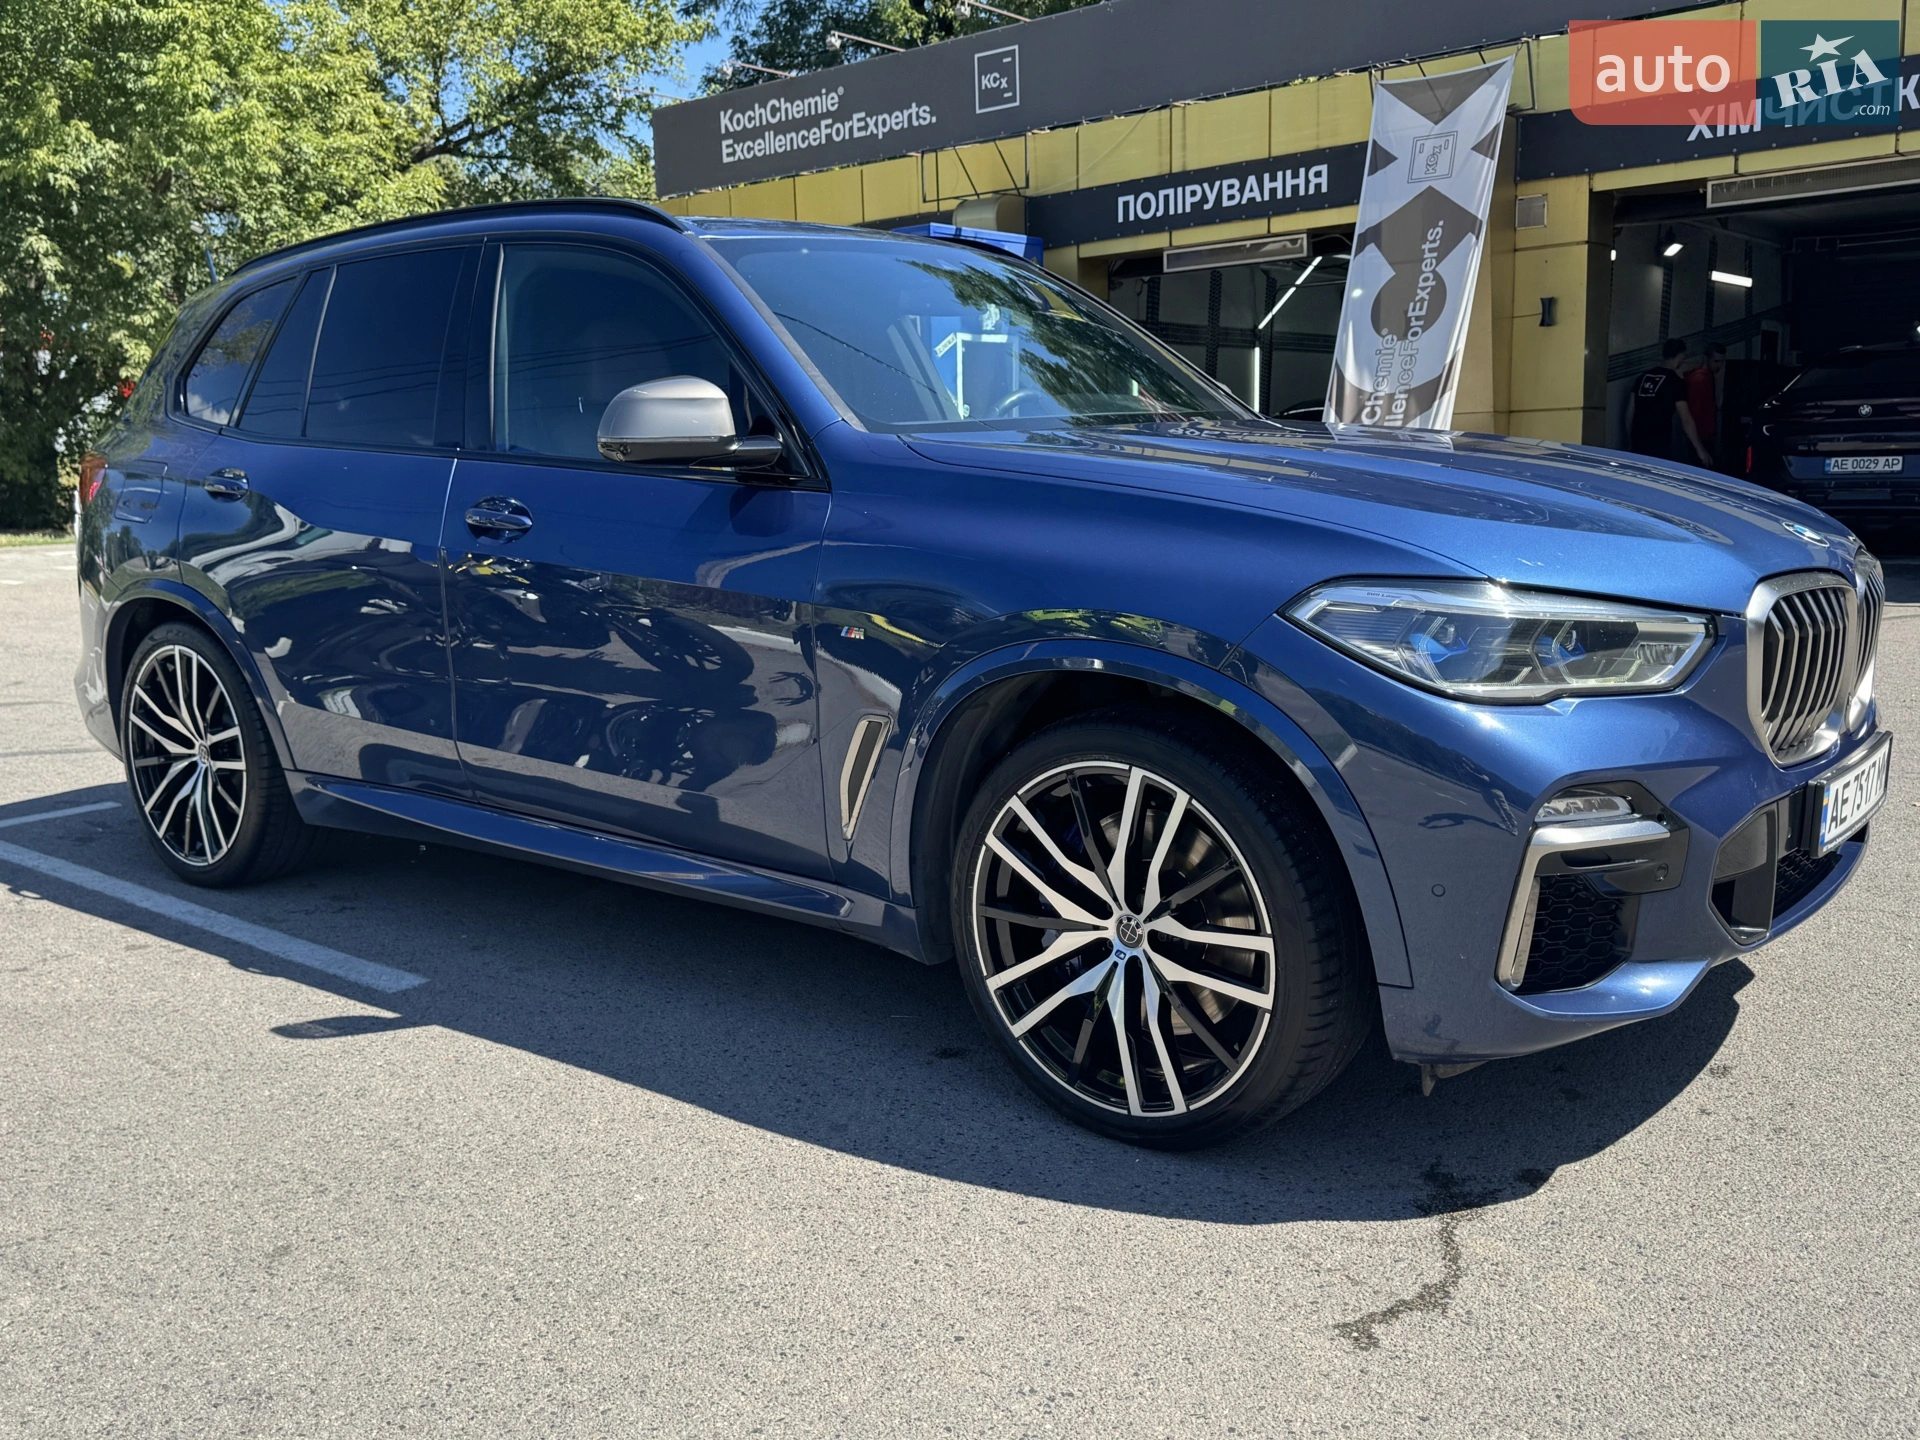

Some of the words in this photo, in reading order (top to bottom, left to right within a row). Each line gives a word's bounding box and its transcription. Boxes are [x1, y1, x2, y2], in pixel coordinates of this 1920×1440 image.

[721, 102, 937, 163] ExcellenceForExperts.
[1117, 163, 1328, 223] ПОЛІРУВАННЯ
[1832, 458, 1849, 470] AE
[1851, 458, 1879, 470] 0029
[1882, 457, 1900, 469] AP
[1828, 780, 1851, 834] AE
